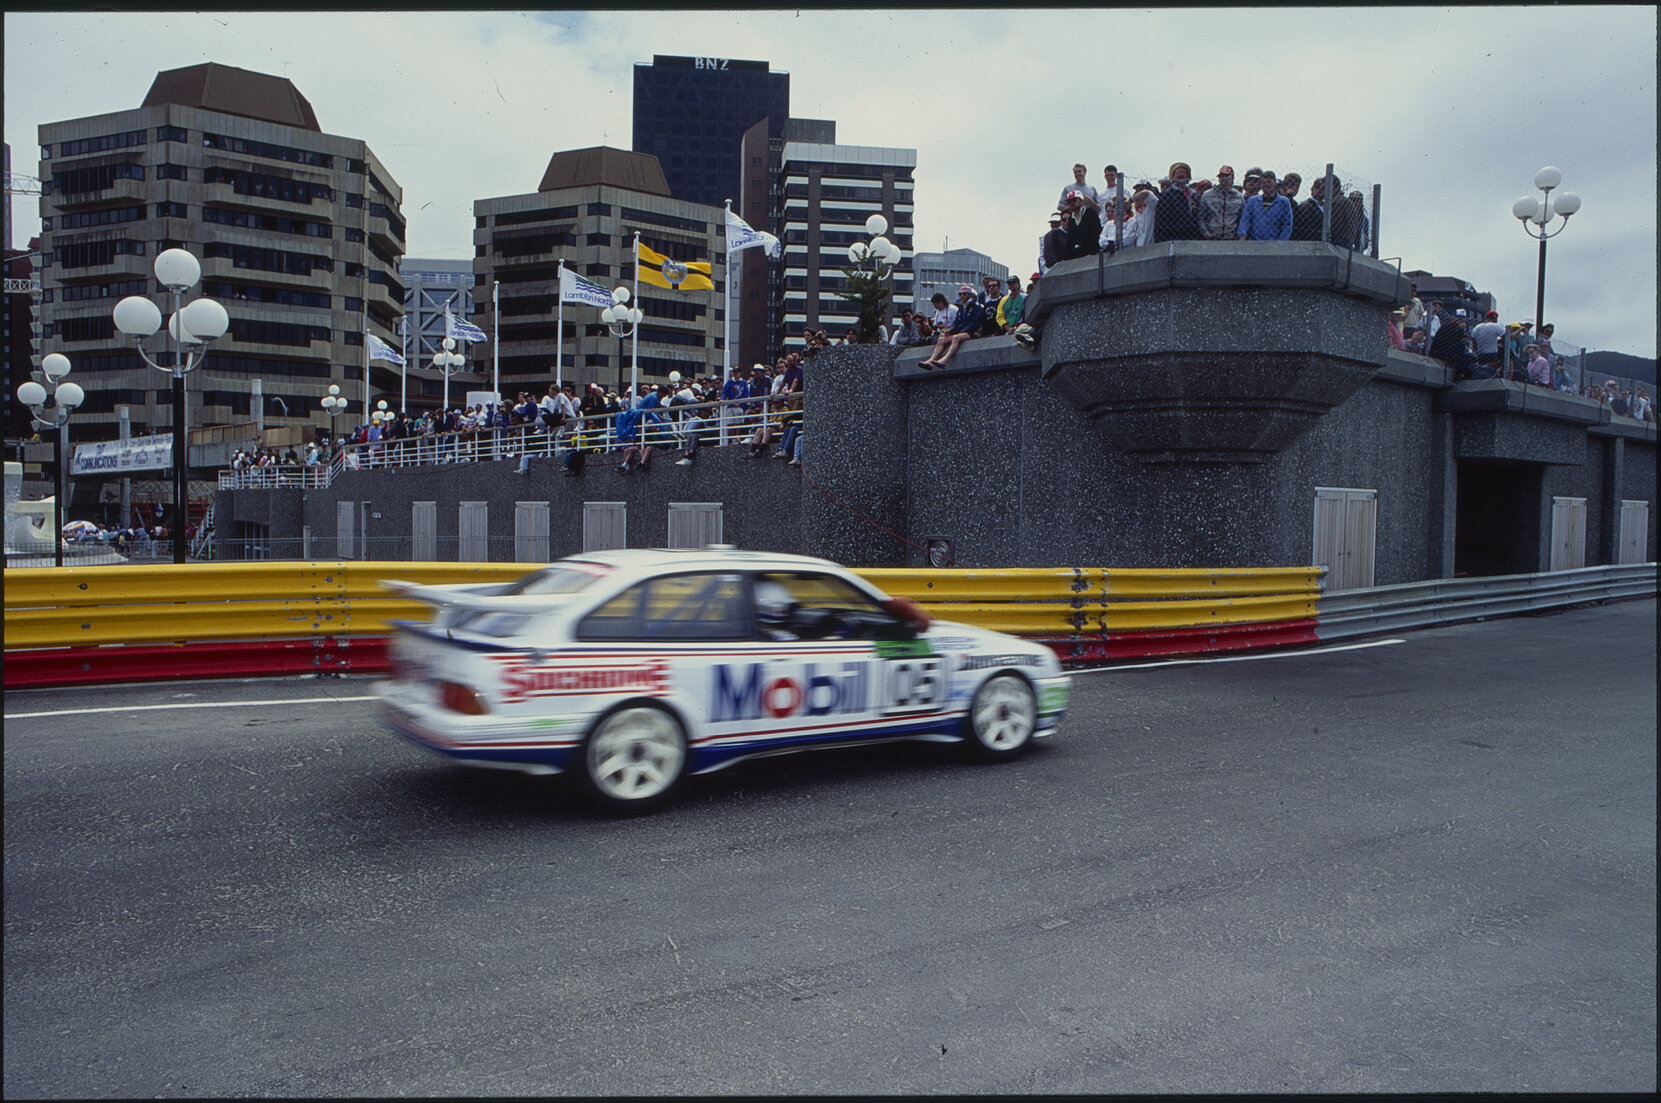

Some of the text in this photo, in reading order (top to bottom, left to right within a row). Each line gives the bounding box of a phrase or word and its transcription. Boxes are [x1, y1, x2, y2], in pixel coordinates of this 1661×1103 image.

[695, 57, 729, 71] BNZ
[564, 291, 594, 302] Lambton
[710, 661, 868, 719] Mobil
